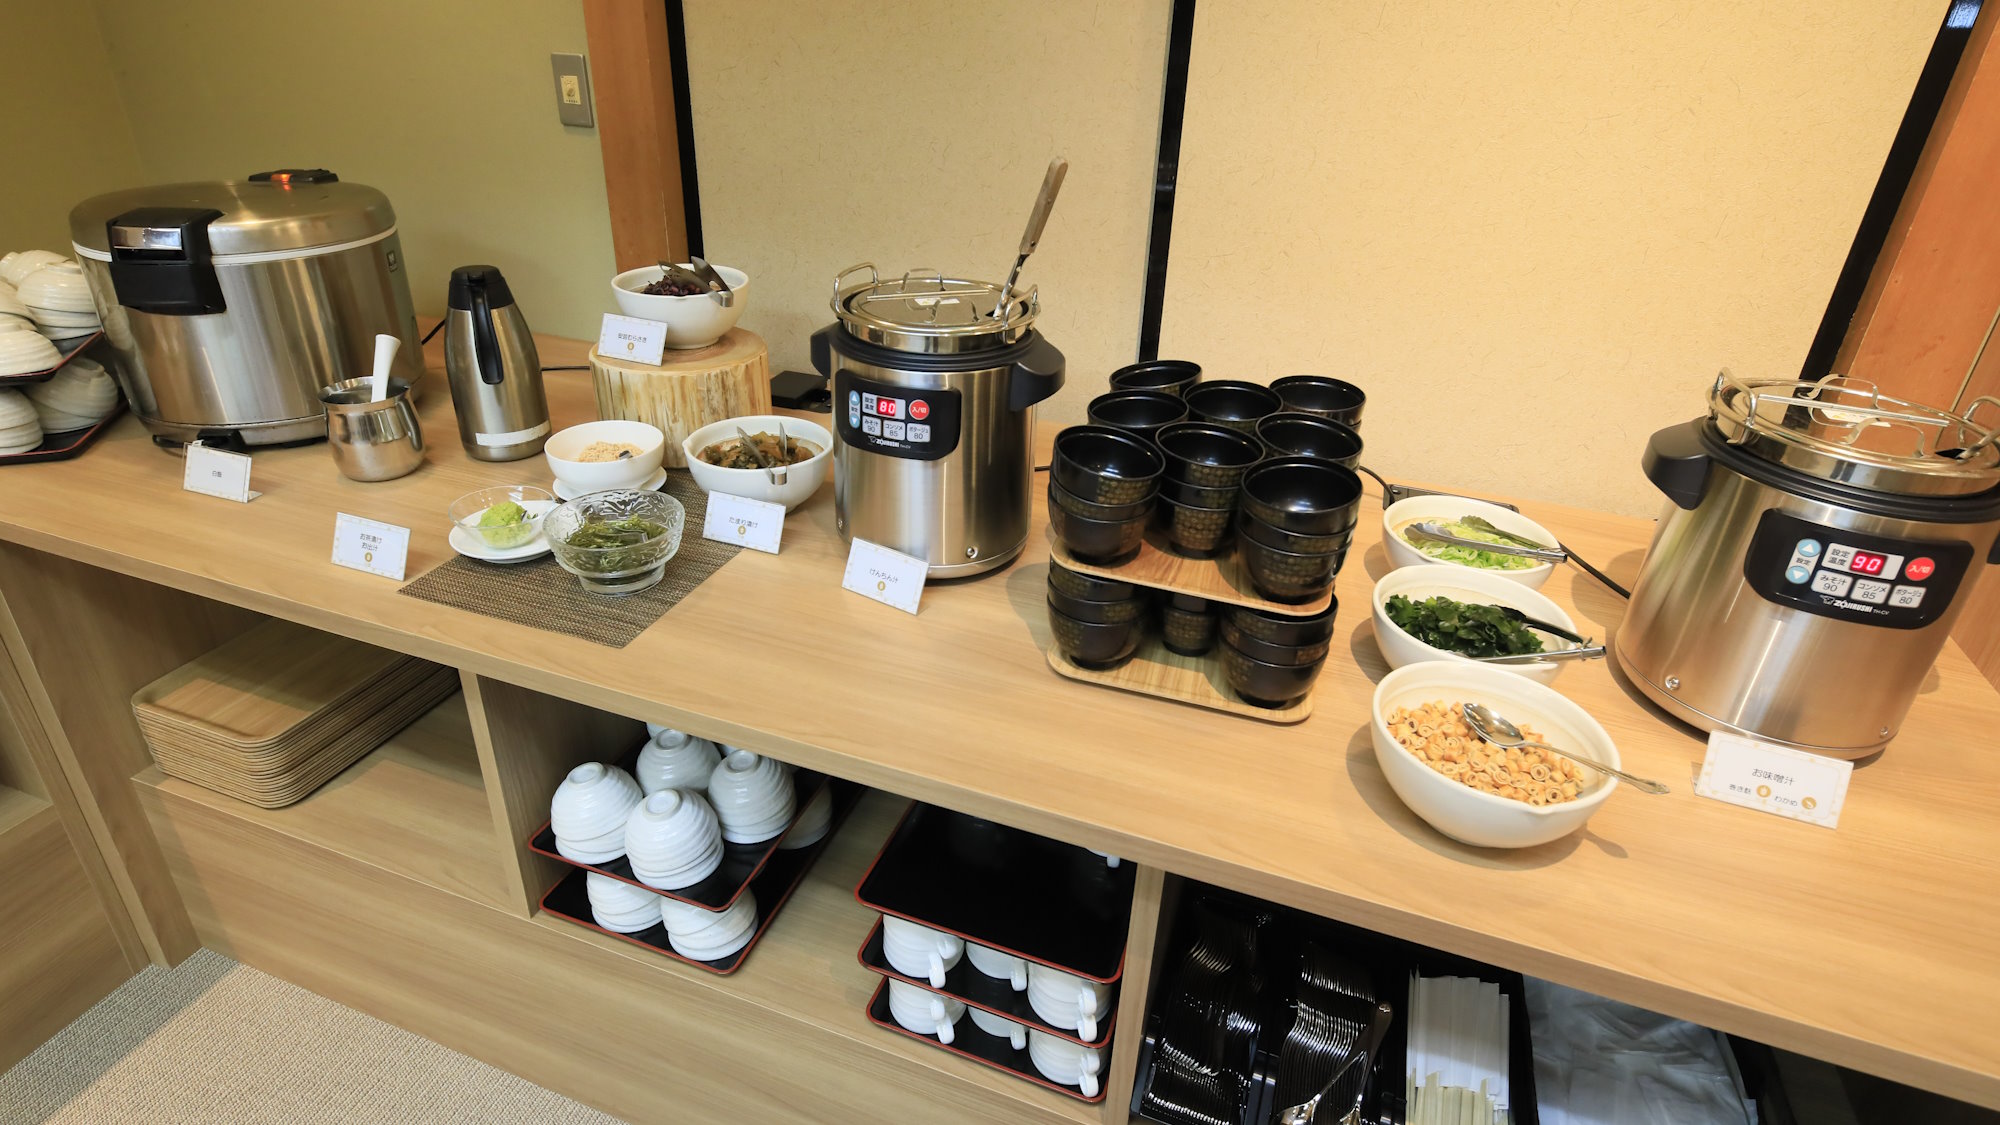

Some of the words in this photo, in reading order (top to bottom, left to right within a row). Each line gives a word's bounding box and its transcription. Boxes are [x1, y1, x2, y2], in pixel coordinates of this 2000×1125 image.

[879, 400, 896, 414] 80
[911, 406, 927, 414] 入/切
[864, 418, 879, 427] みそ汁
[885, 423, 903, 431] コンソメ
[867, 425, 876, 433] 90
[1831, 548, 1851, 559] 設定
[1795, 557, 1812, 567] 設定
[1828, 556, 1847, 567] 温度
[1852, 555, 1881, 571] 90
[1909, 564, 1931, 574] 入/切
[869, 568, 898, 583] けんちん汁
[1820, 574, 1847, 585] みそ汁
[1823, 583, 1838, 592] 90
[1858, 583, 1888, 593] コンソメ
[1862, 591, 1876, 600] 85
[1895, 589, 1923, 598] ポタージュ
[1899, 596, 1913, 605] 80
[1833, 599, 1873, 613] ZOJIRUSHI
[1752, 768, 1795, 786] お味噌汁
[1774, 796, 1798, 807] わかめ
